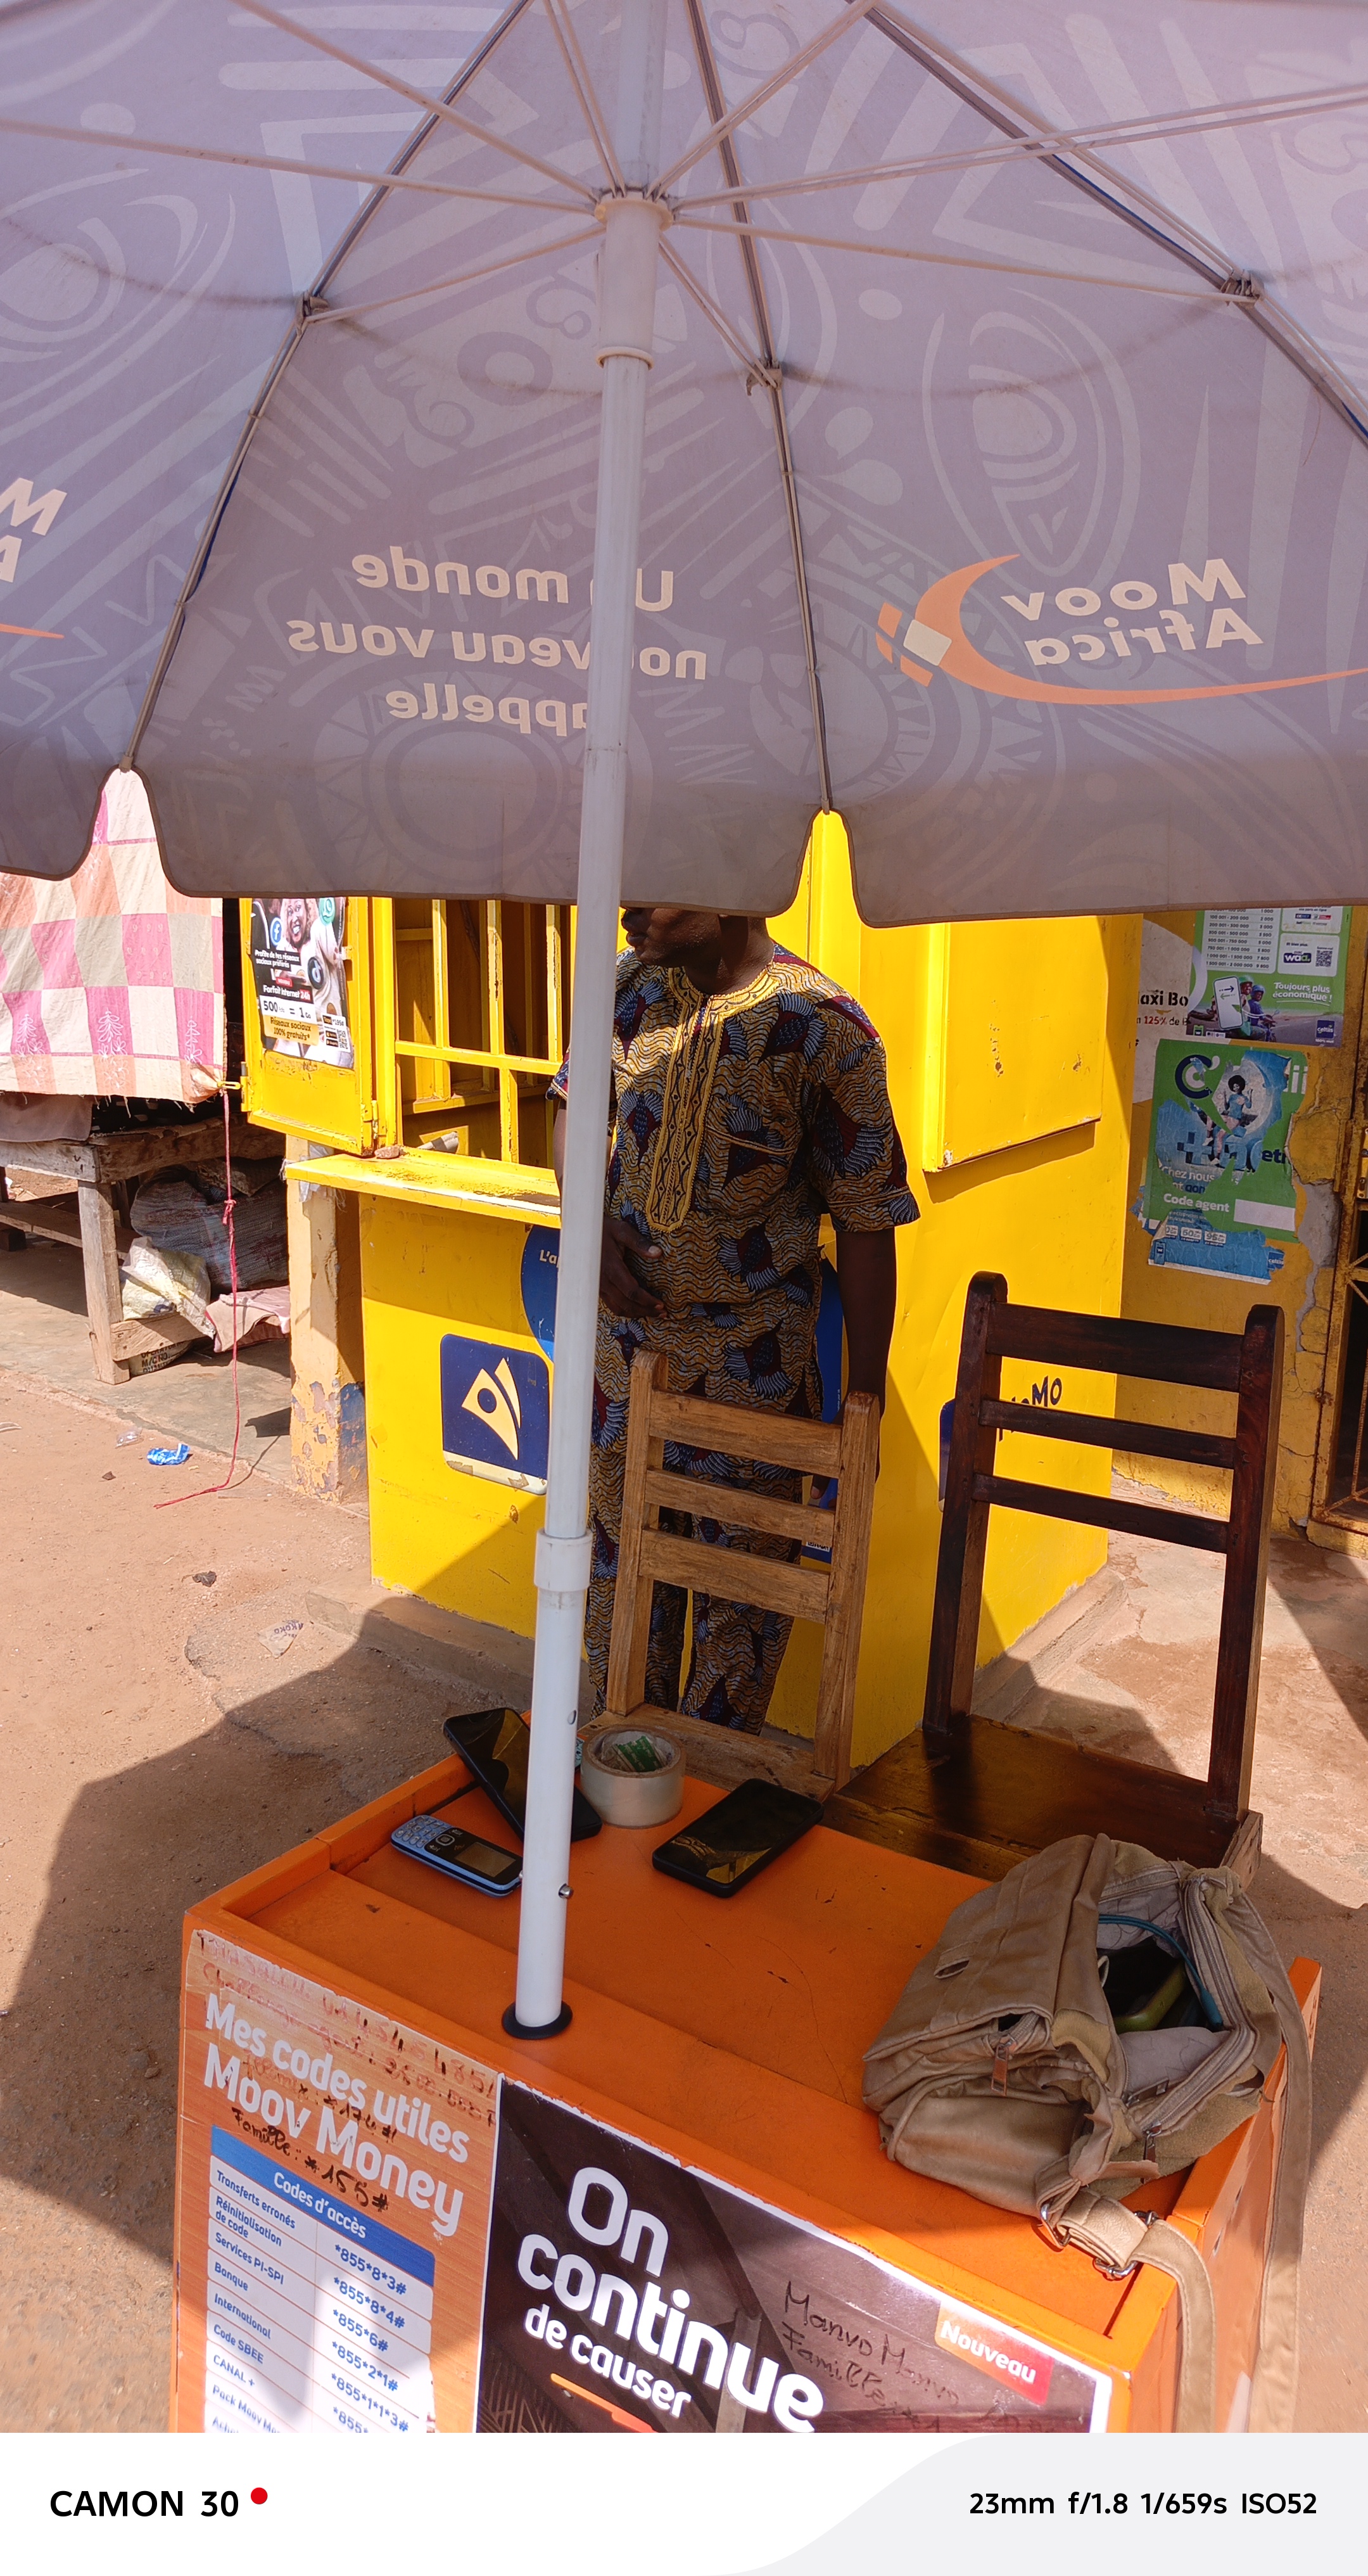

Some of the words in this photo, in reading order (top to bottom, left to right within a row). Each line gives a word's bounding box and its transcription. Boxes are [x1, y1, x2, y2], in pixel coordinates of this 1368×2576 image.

[255, 950, 269, 958] Profite
[282, 953, 300, 962] réseaux
[263, 985, 280, 994] Forfait
[281, 988, 300, 998] Internet
[300, 992, 310, 1000] 24h
[1138, 991, 1163, 1005] axi
[1272, 992, 1327, 1001] économique
[1274, 982, 1310, 991] Toujours
[1312, 985, 1330, 993] plus
[263, 1000, 278, 1012] 500
[1144, 1016, 1167, 1025] 125%
[1169, 1017, 1179, 1025] de
[270, 1017, 289, 1028] Réseaux
[291, 1023, 311, 1031] sociaux
[274, 1027, 285, 1036] 100%
[1163, 1193, 1193, 1206] Code
[1195, 1200, 1229, 1213] agent
[206, 1993, 266, 2058] Mes
[273, 2041, 367, 2110] codes
[374, 2089, 469, 2163] utiles
[205, 2043, 312, 2139] Moov
[316, 2105, 464, 2237] Money
[217, 2169, 260, 2207] Transferts
[262, 2202, 296, 2229] erronés
[274, 2171, 314, 2208] Codes
[315, 2197, 367, 2239] d'accès
[215, 2210, 226, 2223] de
[228, 2219, 248, 2238] code
[216, 2195, 282, 2247] Réinitialisation
[568, 2167, 669, 2278] On
[215, 2232, 252, 2264] Services
[254, 2257, 284, 2285] PI-SPI
[215, 2262, 248, 2291] Banque
[214, 2293, 271, 2340] International
[517, 2233, 824, 2433] continue
[213, 2324, 236, 2345] Code
[238, 2340, 263, 2364] SBEE
[940, 2319, 1037, 2385] Nouveau
[213, 2354, 246, 2383] CANAL
[524, 2304, 567, 2350] de
[571, 2333, 692, 2419] causer
[213, 2384, 236, 2406] Pack
[238, 2399, 262, 2424] Moov
